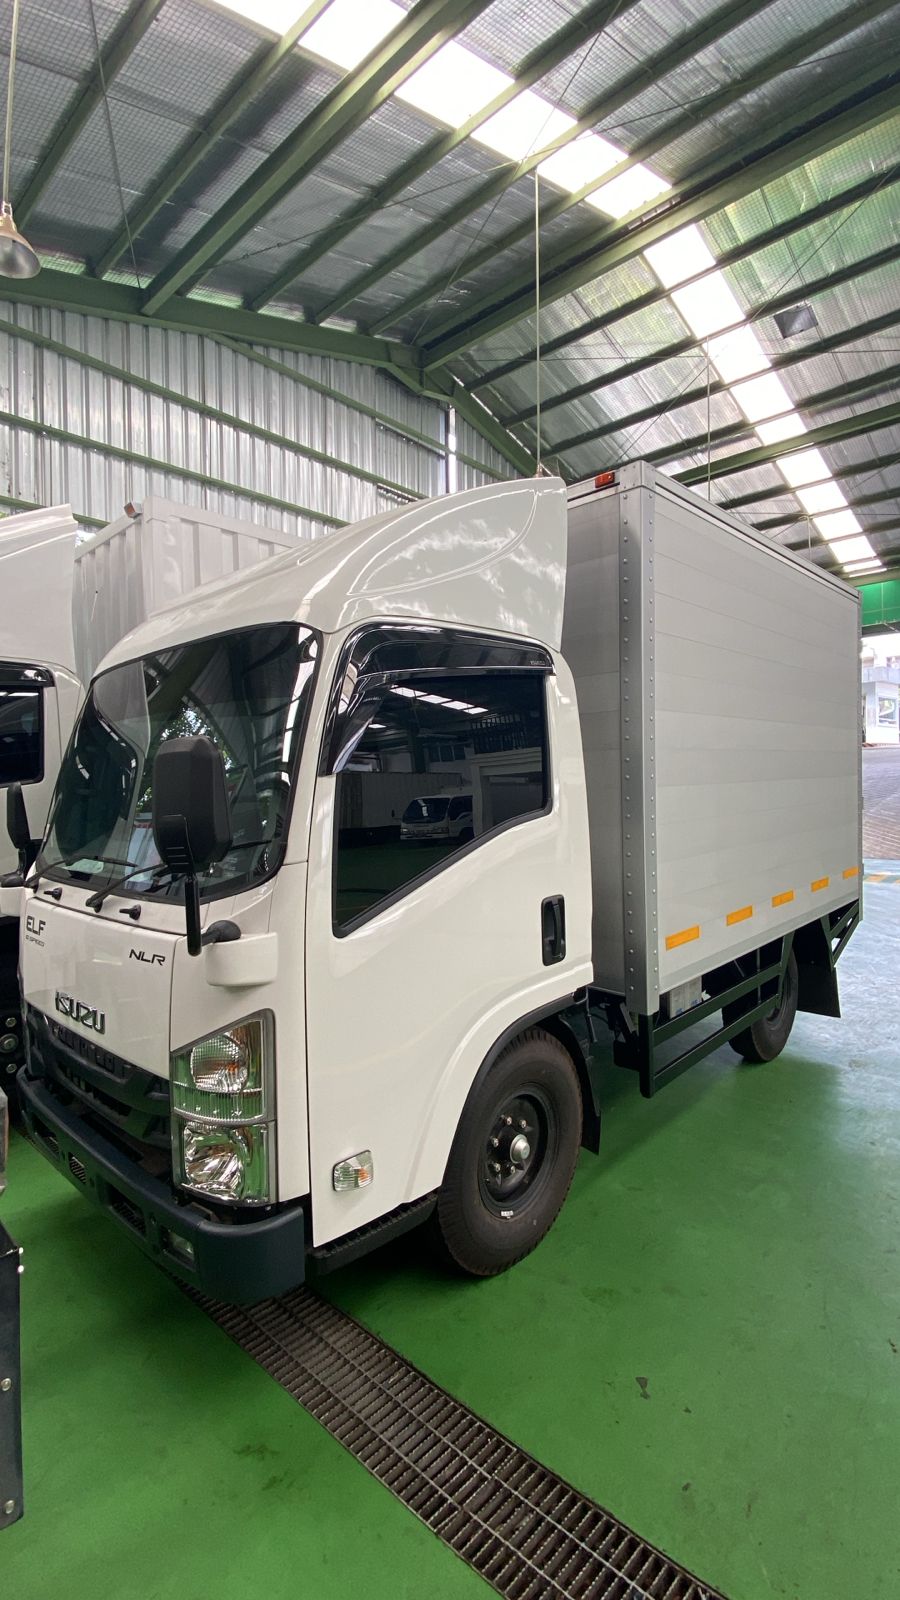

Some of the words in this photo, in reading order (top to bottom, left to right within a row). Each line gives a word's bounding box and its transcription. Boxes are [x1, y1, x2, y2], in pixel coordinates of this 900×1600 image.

[26, 915, 46, 936] ELF
[129, 949, 166, 966] NLR
[55, 991, 105, 1035] ISUZU
